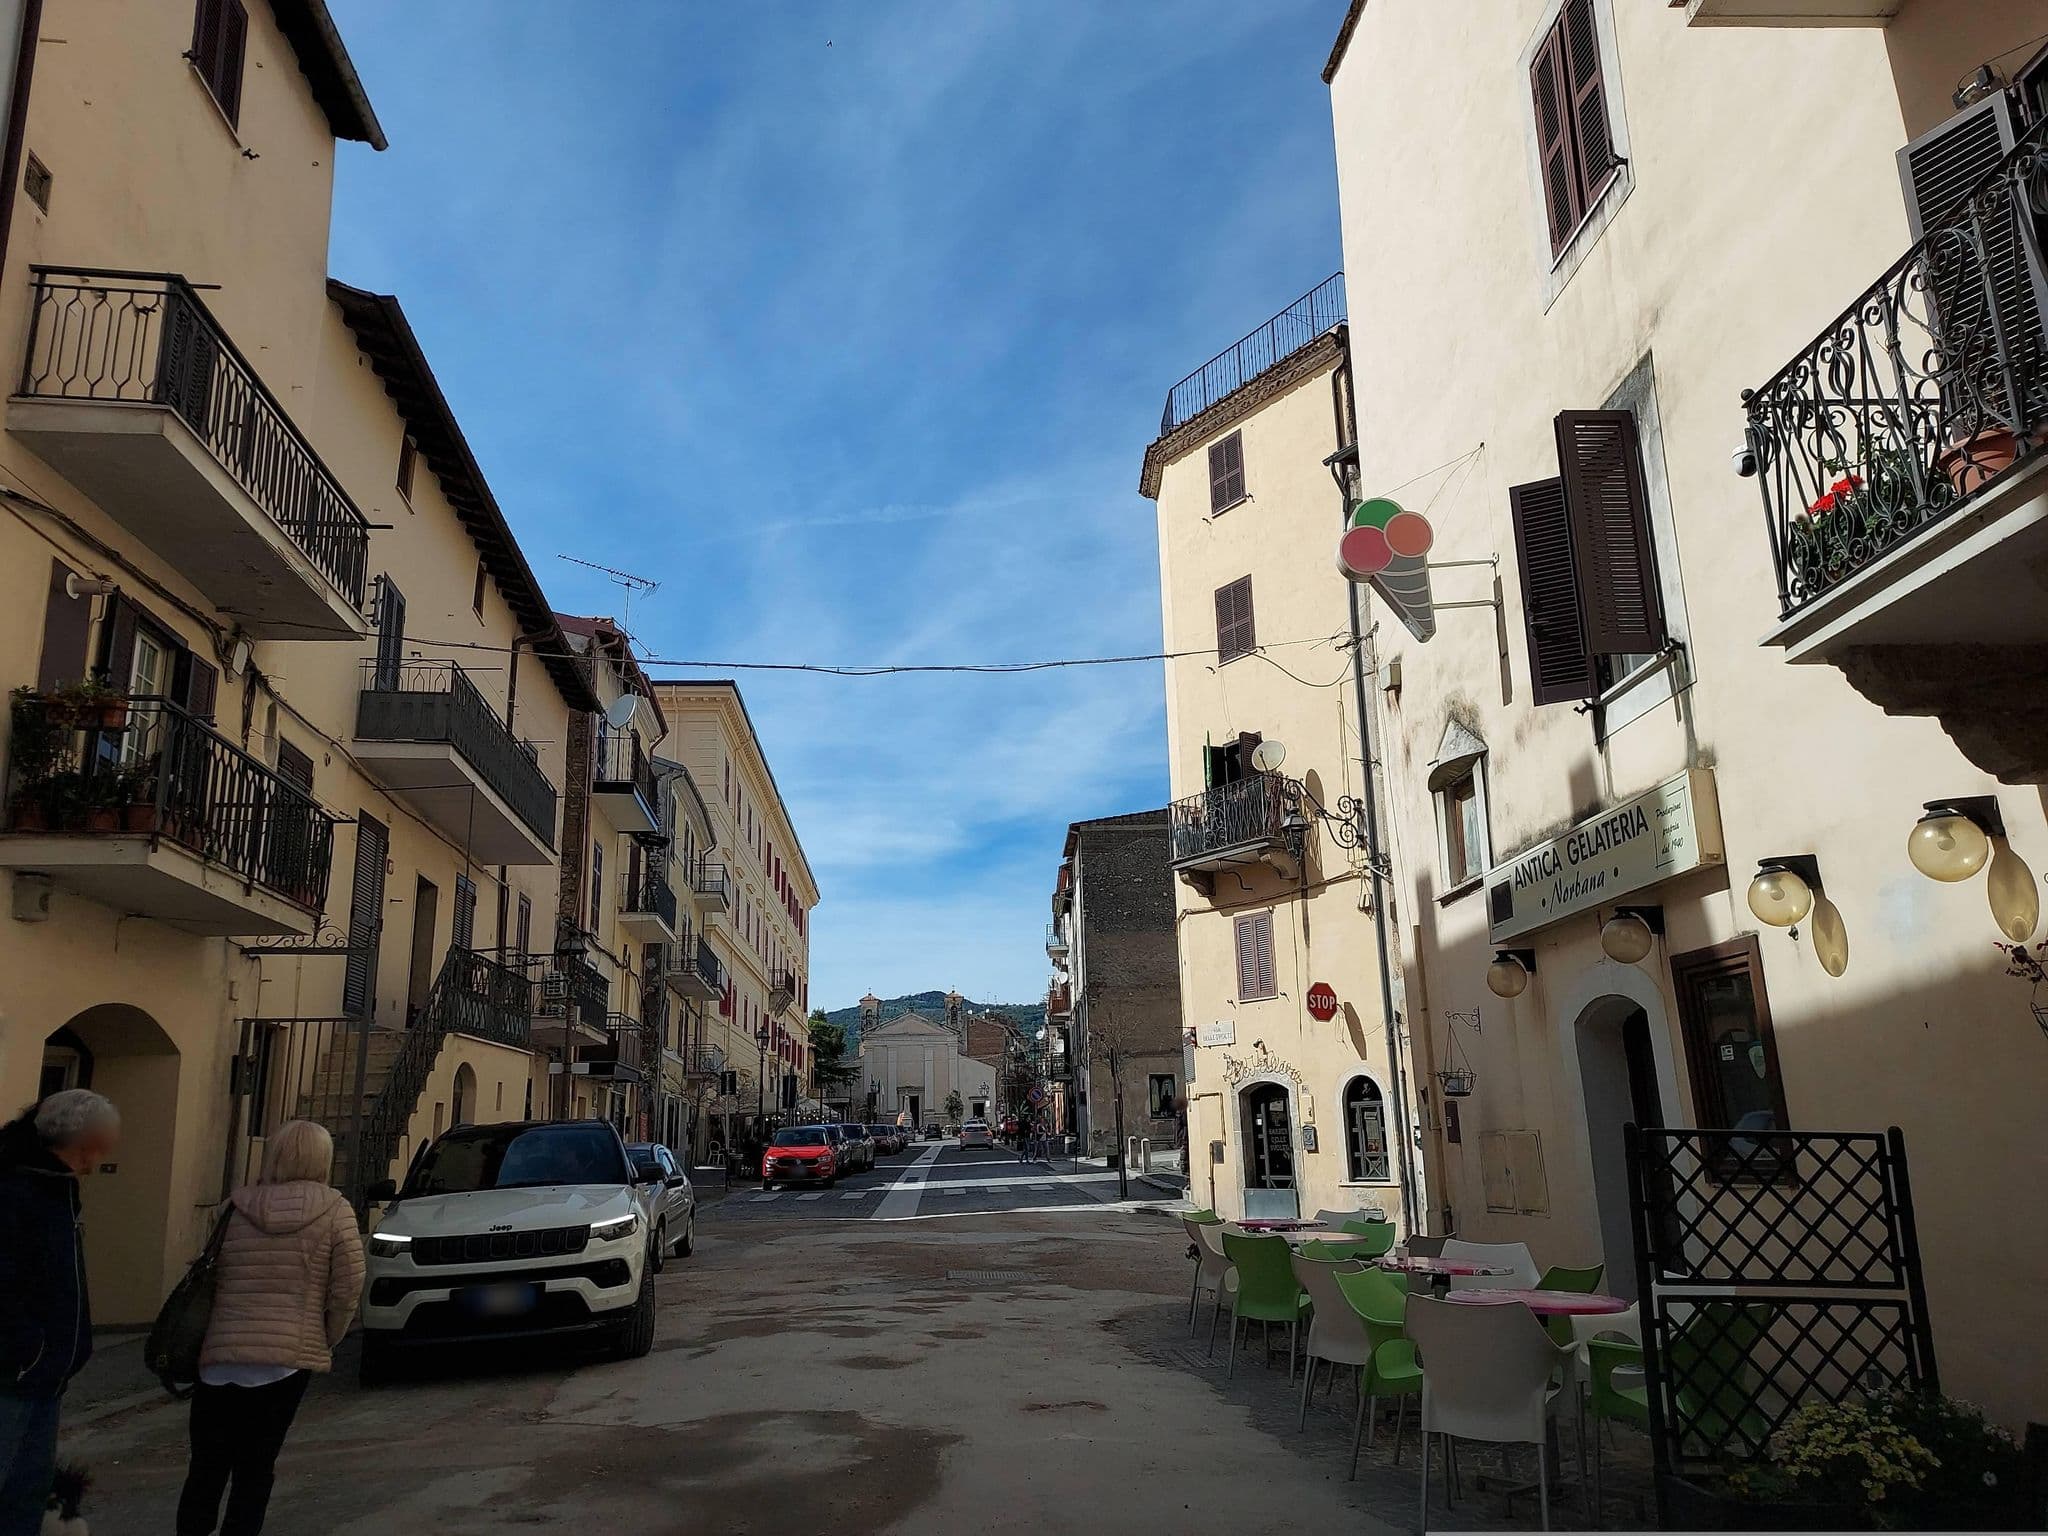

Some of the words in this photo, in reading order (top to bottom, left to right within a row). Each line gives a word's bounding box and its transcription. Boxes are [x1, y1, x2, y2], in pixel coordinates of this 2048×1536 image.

[1514, 847, 1563, 892] ANTICA
[1566, 804, 1649, 866] GELATERIA
[1549, 870, 1605, 914] Norbana
[1309, 994, 1336, 1010] STOP
[489, 1224, 513, 1232] Jeep
